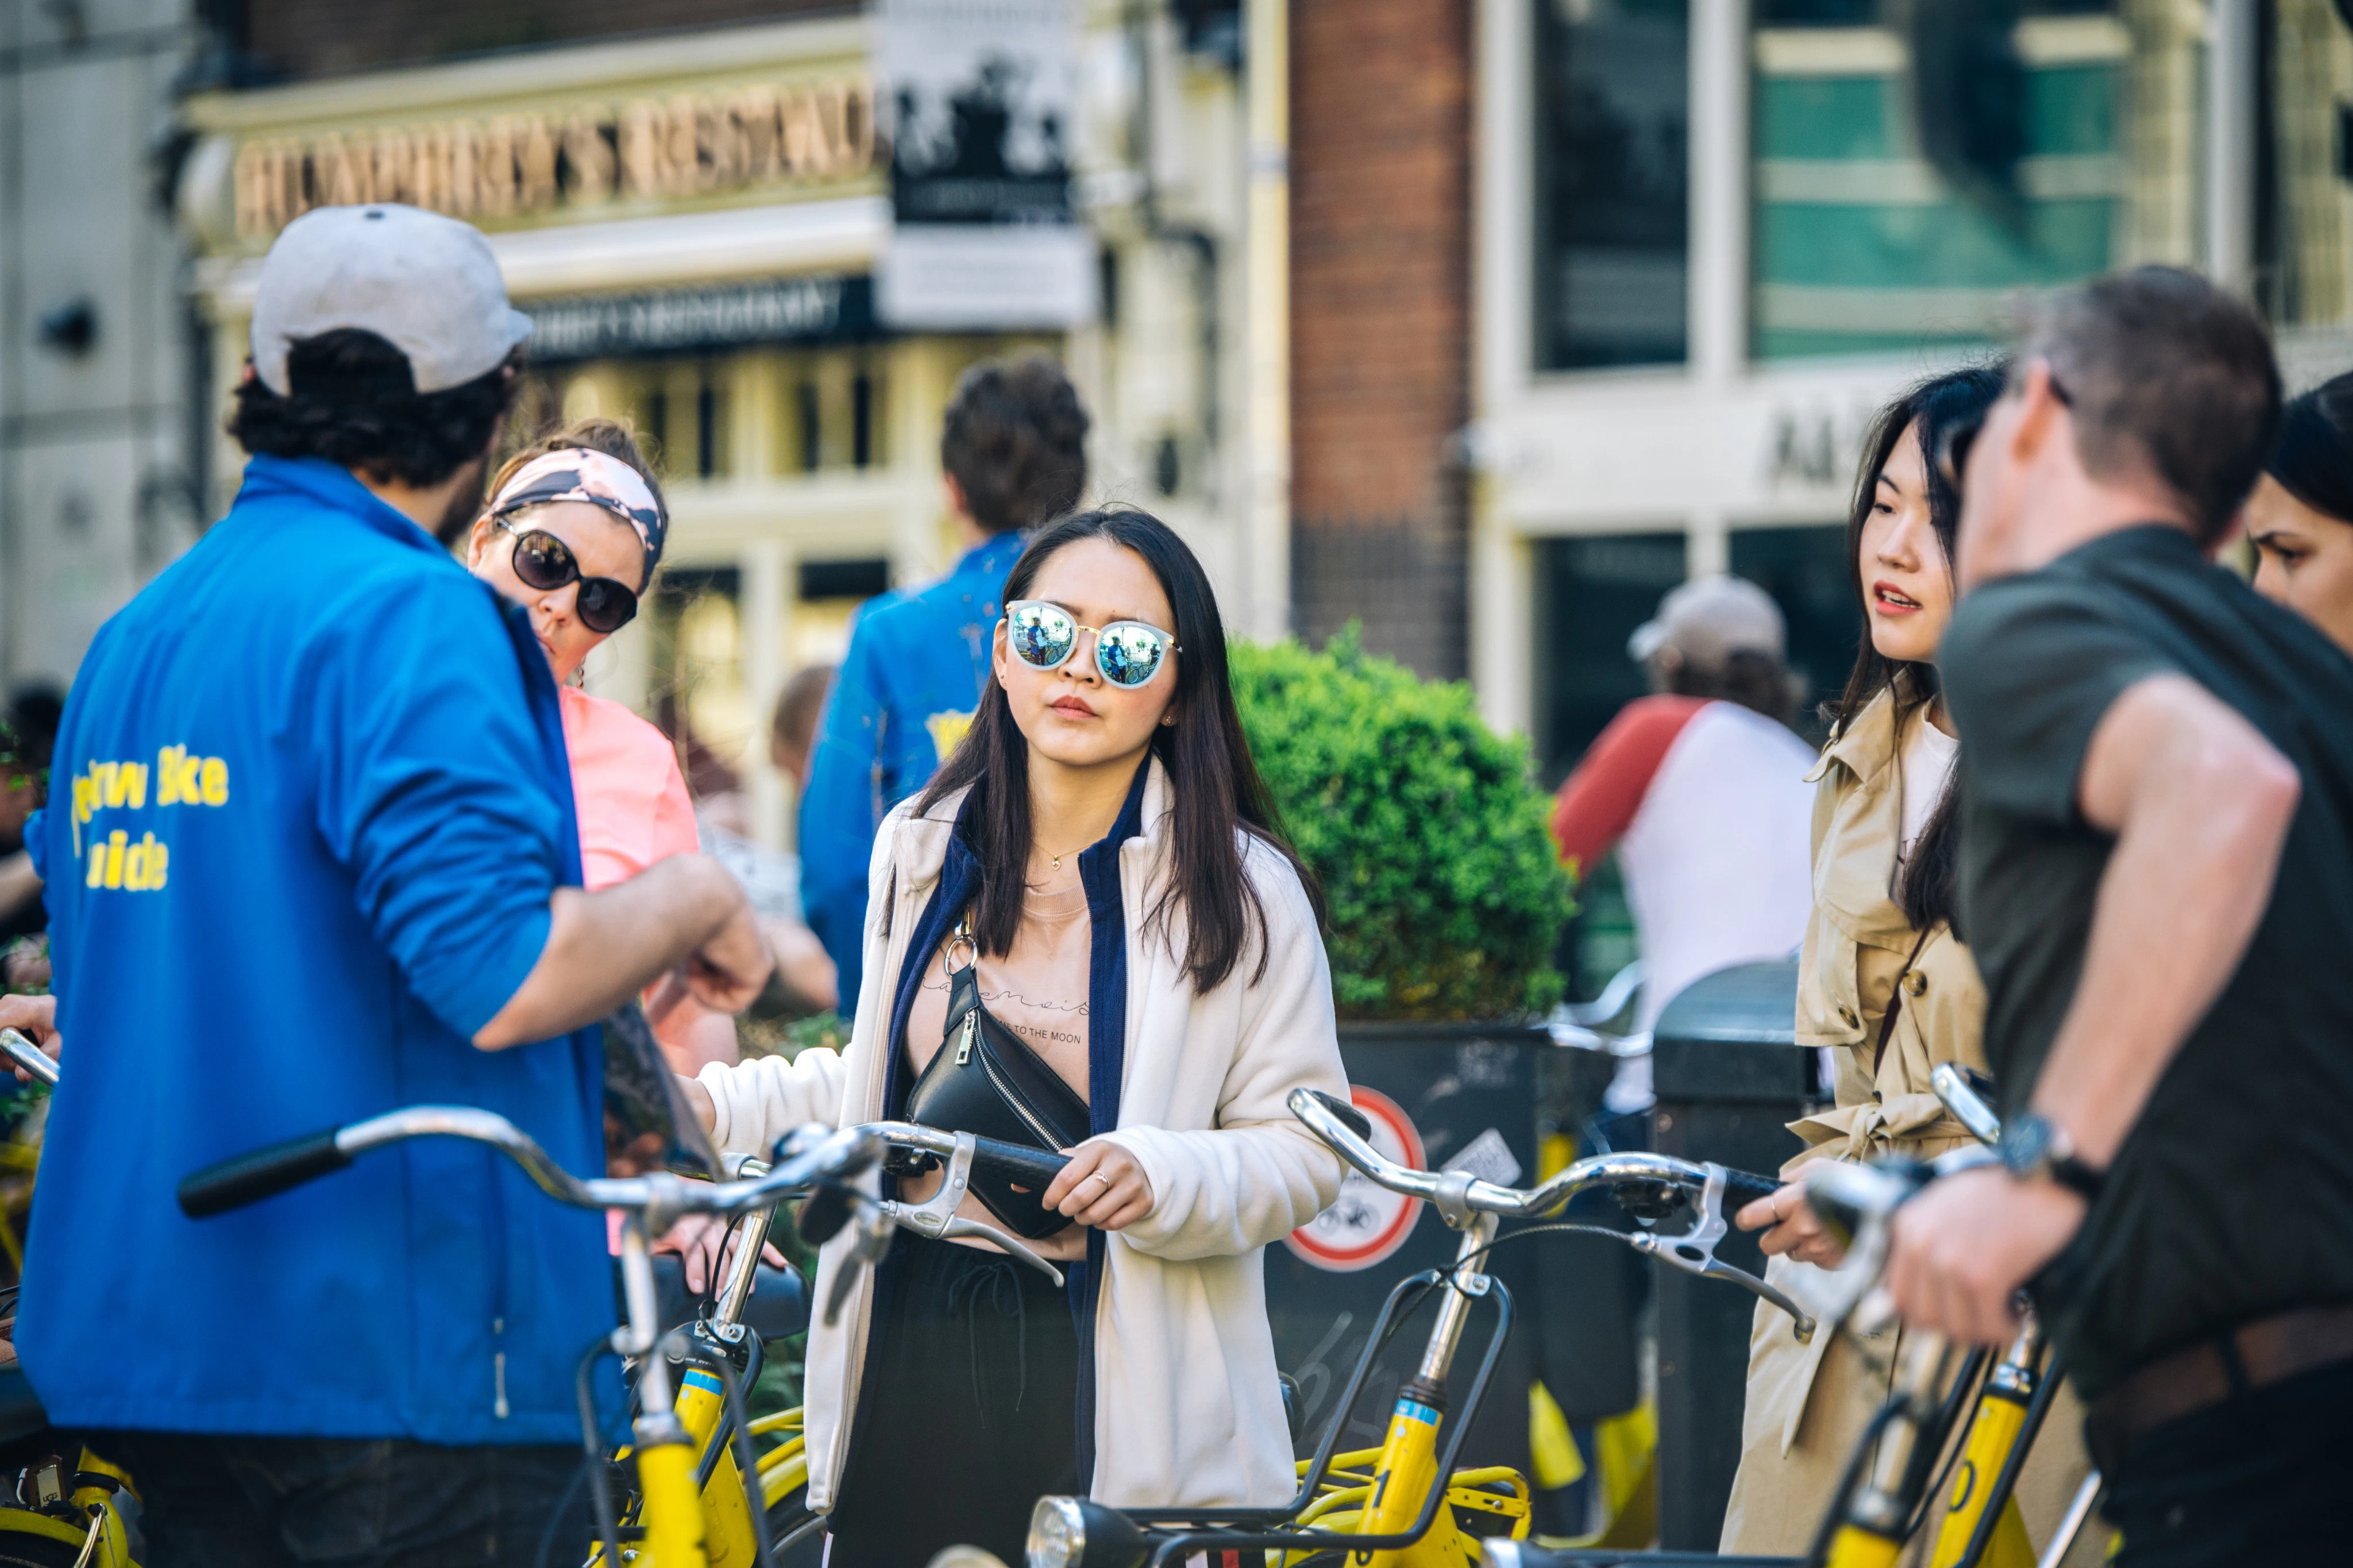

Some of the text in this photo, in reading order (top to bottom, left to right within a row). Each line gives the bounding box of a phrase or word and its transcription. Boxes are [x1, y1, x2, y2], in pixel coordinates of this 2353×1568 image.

[1014, 1024, 1027, 1034] TO
[1029, 1028, 1048, 1039] THE
[1051, 1032, 1081, 1044] MOON
[43, 1492, 58, 1503] UGG
